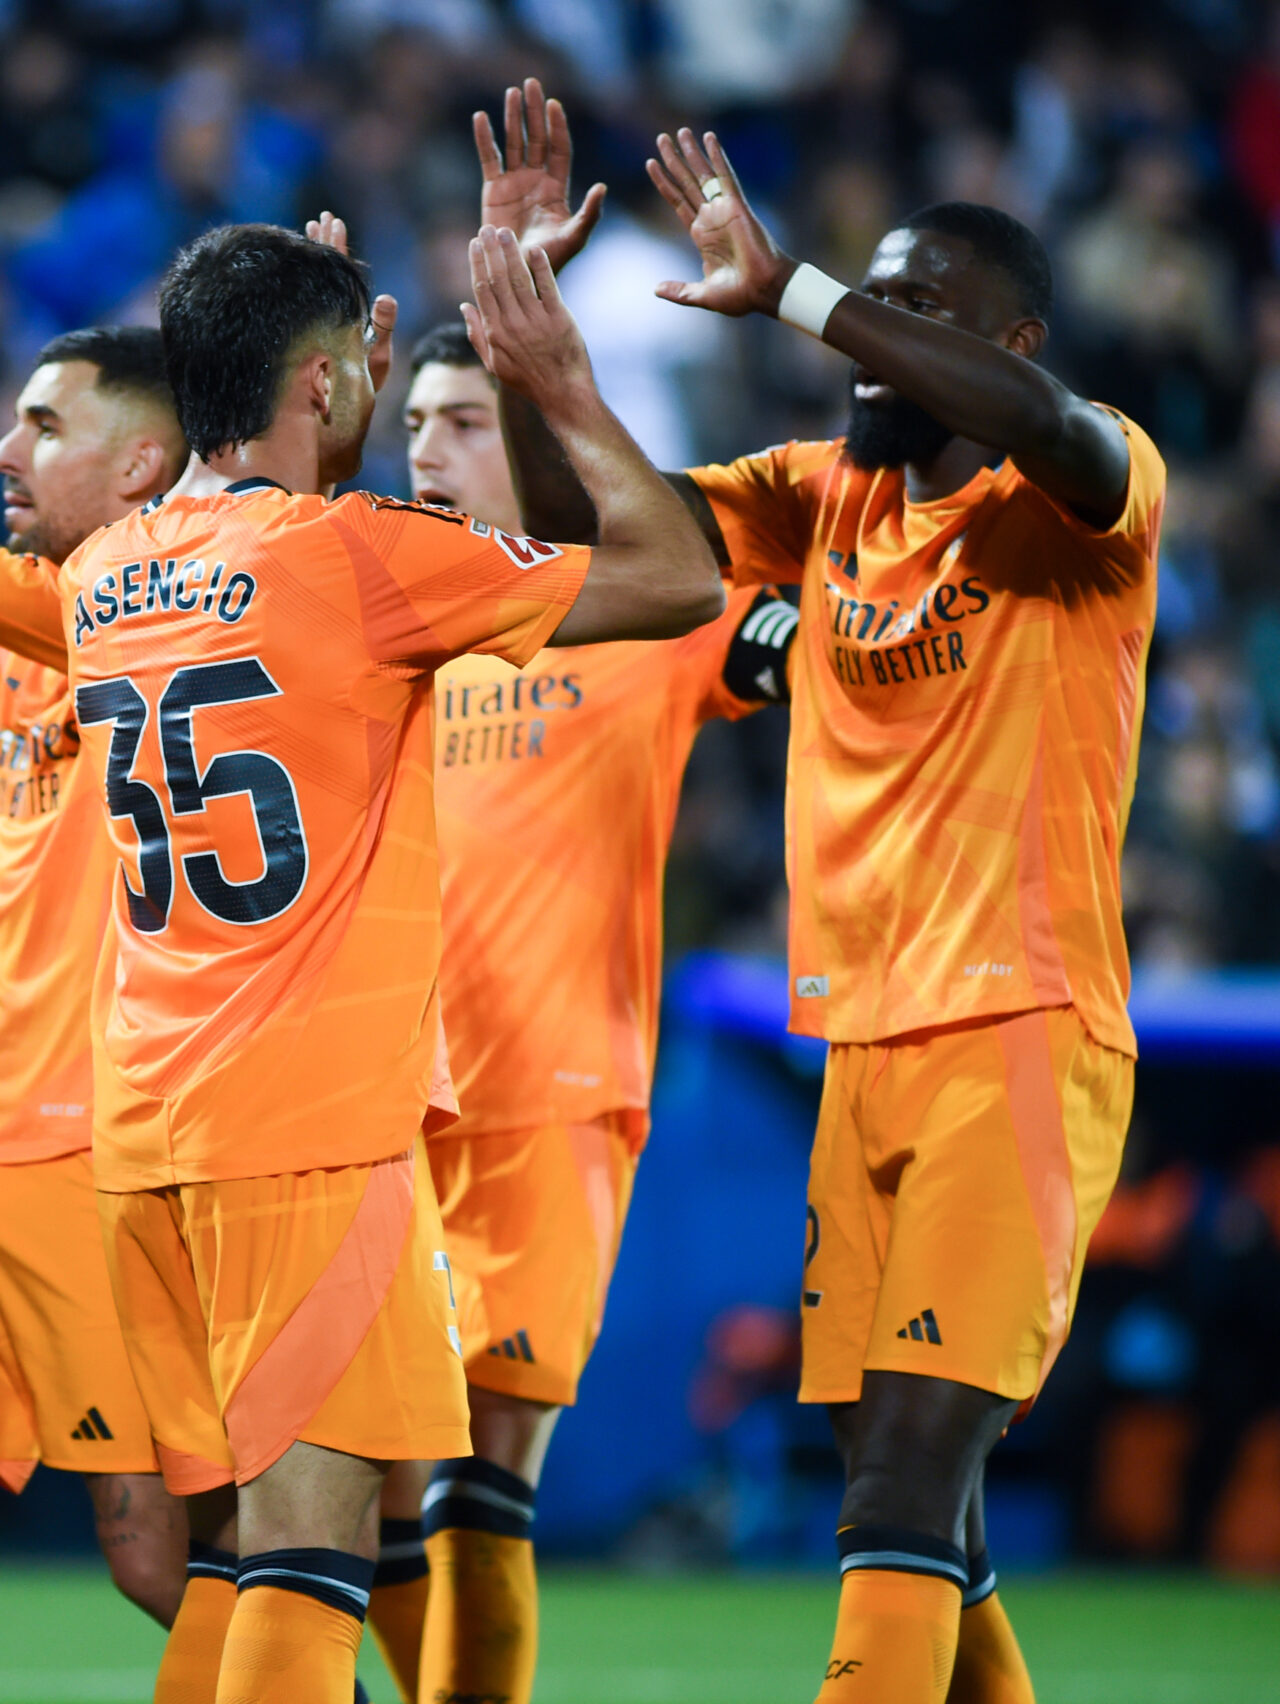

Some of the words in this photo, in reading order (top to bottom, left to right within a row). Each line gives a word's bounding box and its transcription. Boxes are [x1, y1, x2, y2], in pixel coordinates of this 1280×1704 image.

[75, 557, 257, 648] ASENCIO
[869, 630, 968, 687] BETTER
[445, 673, 584, 720] irates
[445, 718, 546, 768] BETTER
[75, 656, 310, 935] 35
